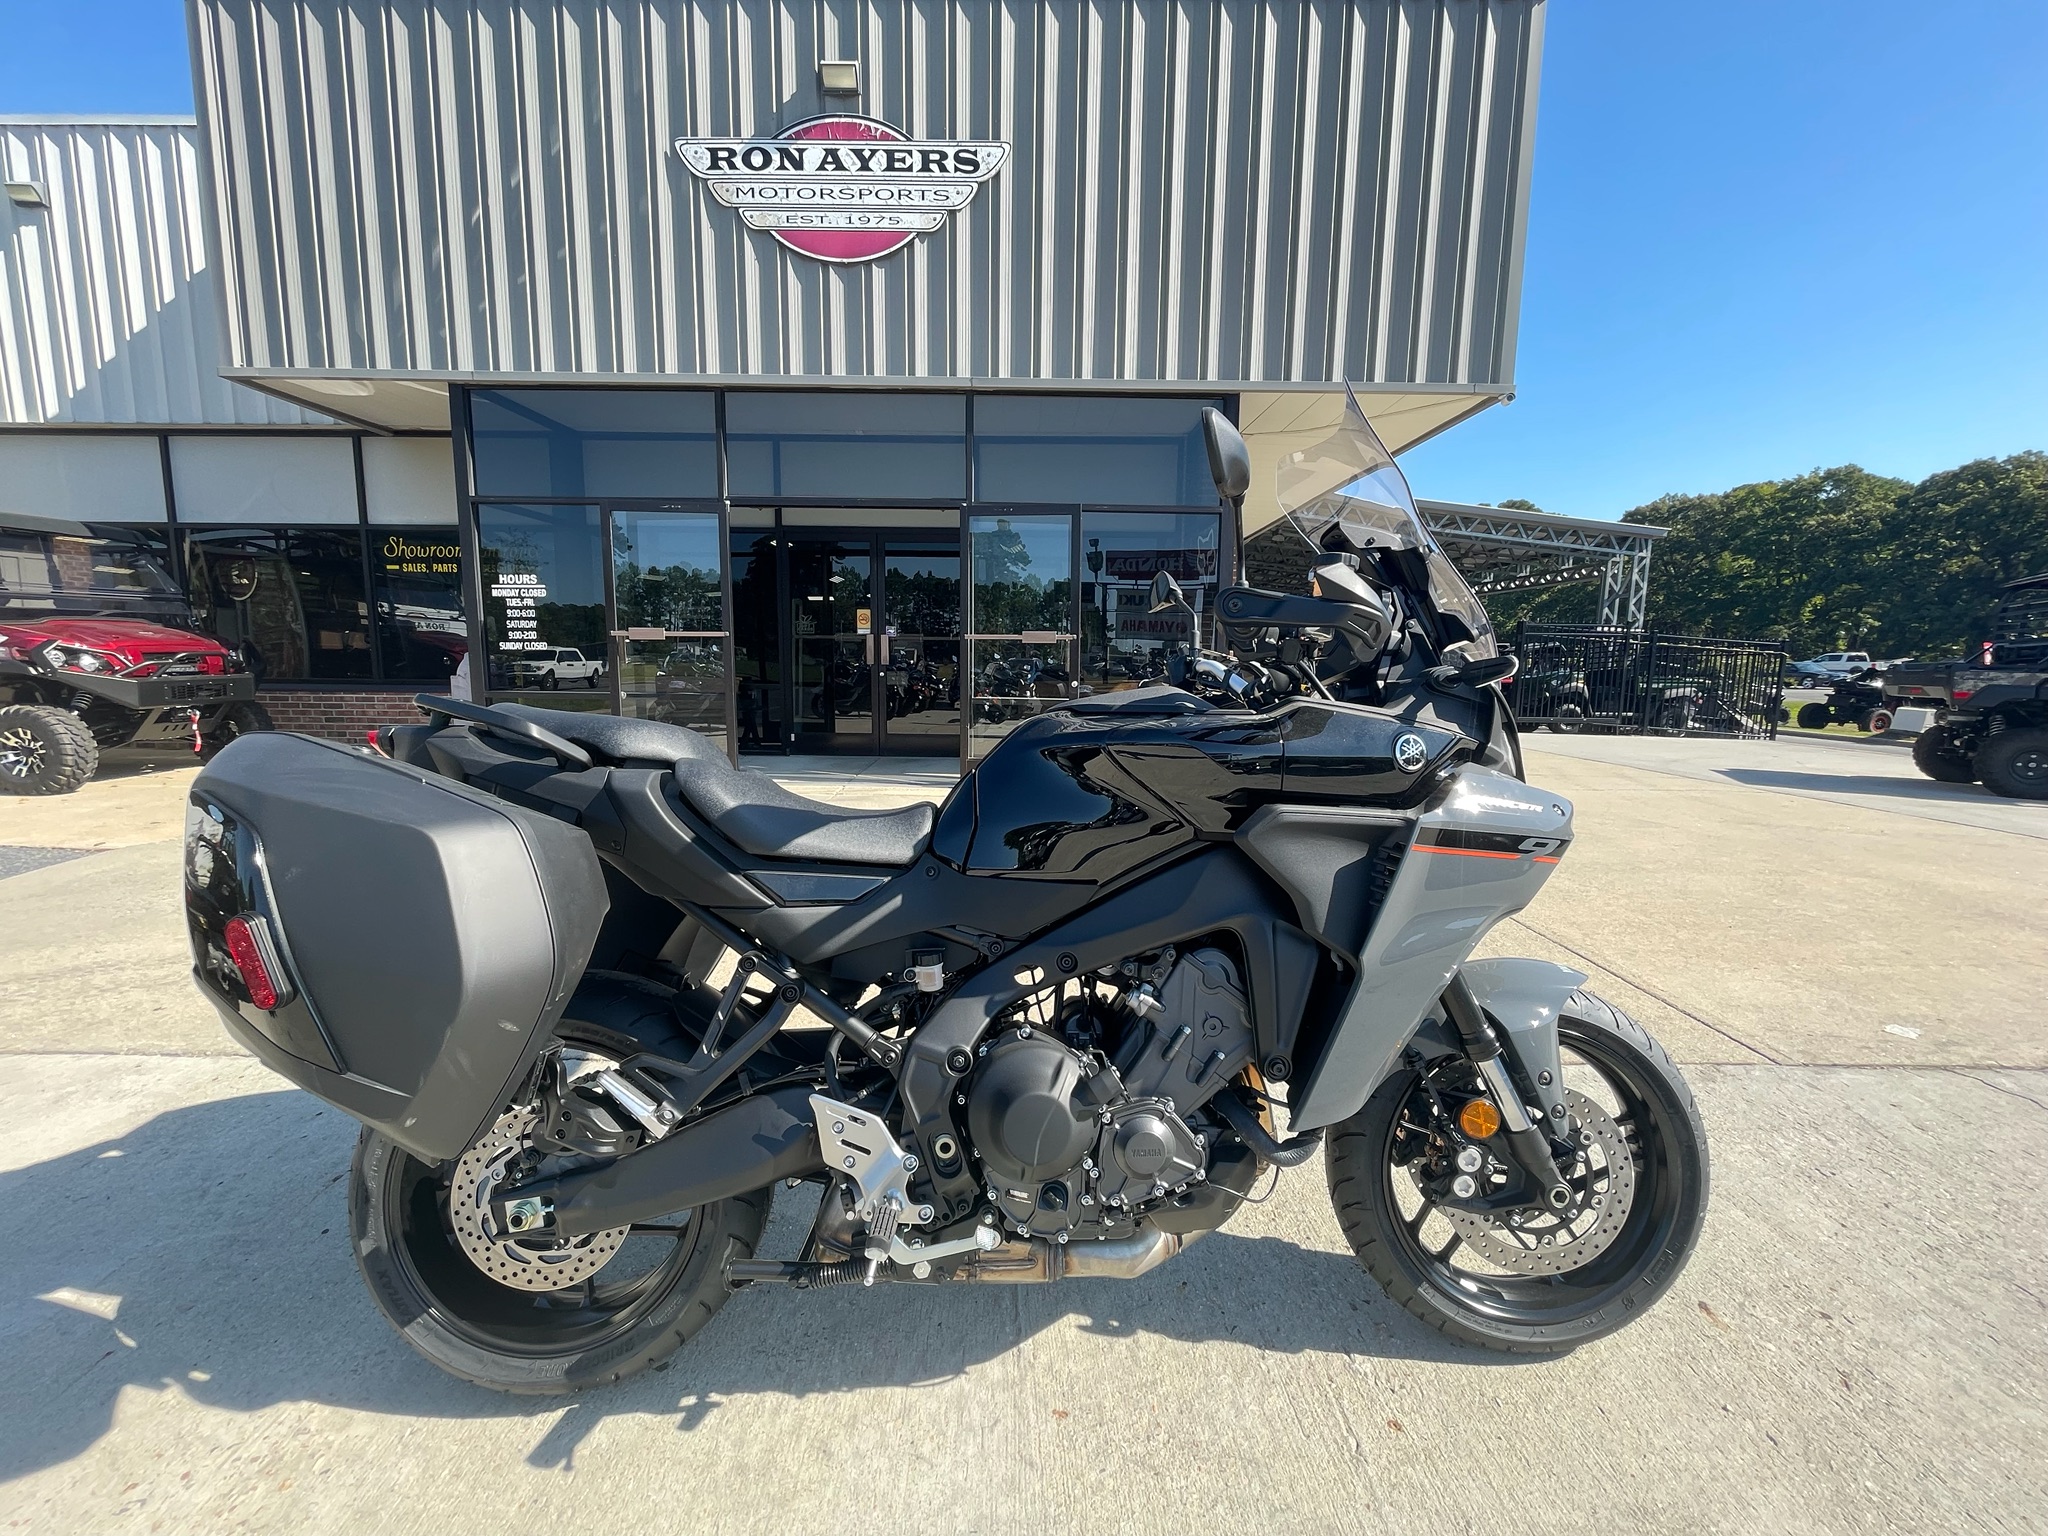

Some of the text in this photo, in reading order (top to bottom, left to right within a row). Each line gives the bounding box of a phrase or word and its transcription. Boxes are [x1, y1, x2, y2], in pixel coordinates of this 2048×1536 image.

[705, 147, 981, 174] RON AYERS
[735, 187, 950, 202] MOTORSPORTS
[786, 215, 901, 226] EST. 1975
[402, 563, 458, 574] SALES, PARTS
[498, 574, 538, 584] HOURS
[491, 588, 547, 597] MONDAY CLOSED
[506, 620, 537, 628] SATURDAY
[508, 631, 537, 639] 9:00-2:00
[498, 641, 548, 651] SUNDAY CLOSED
[1131, 1148, 1162, 1158] YAMAHA
